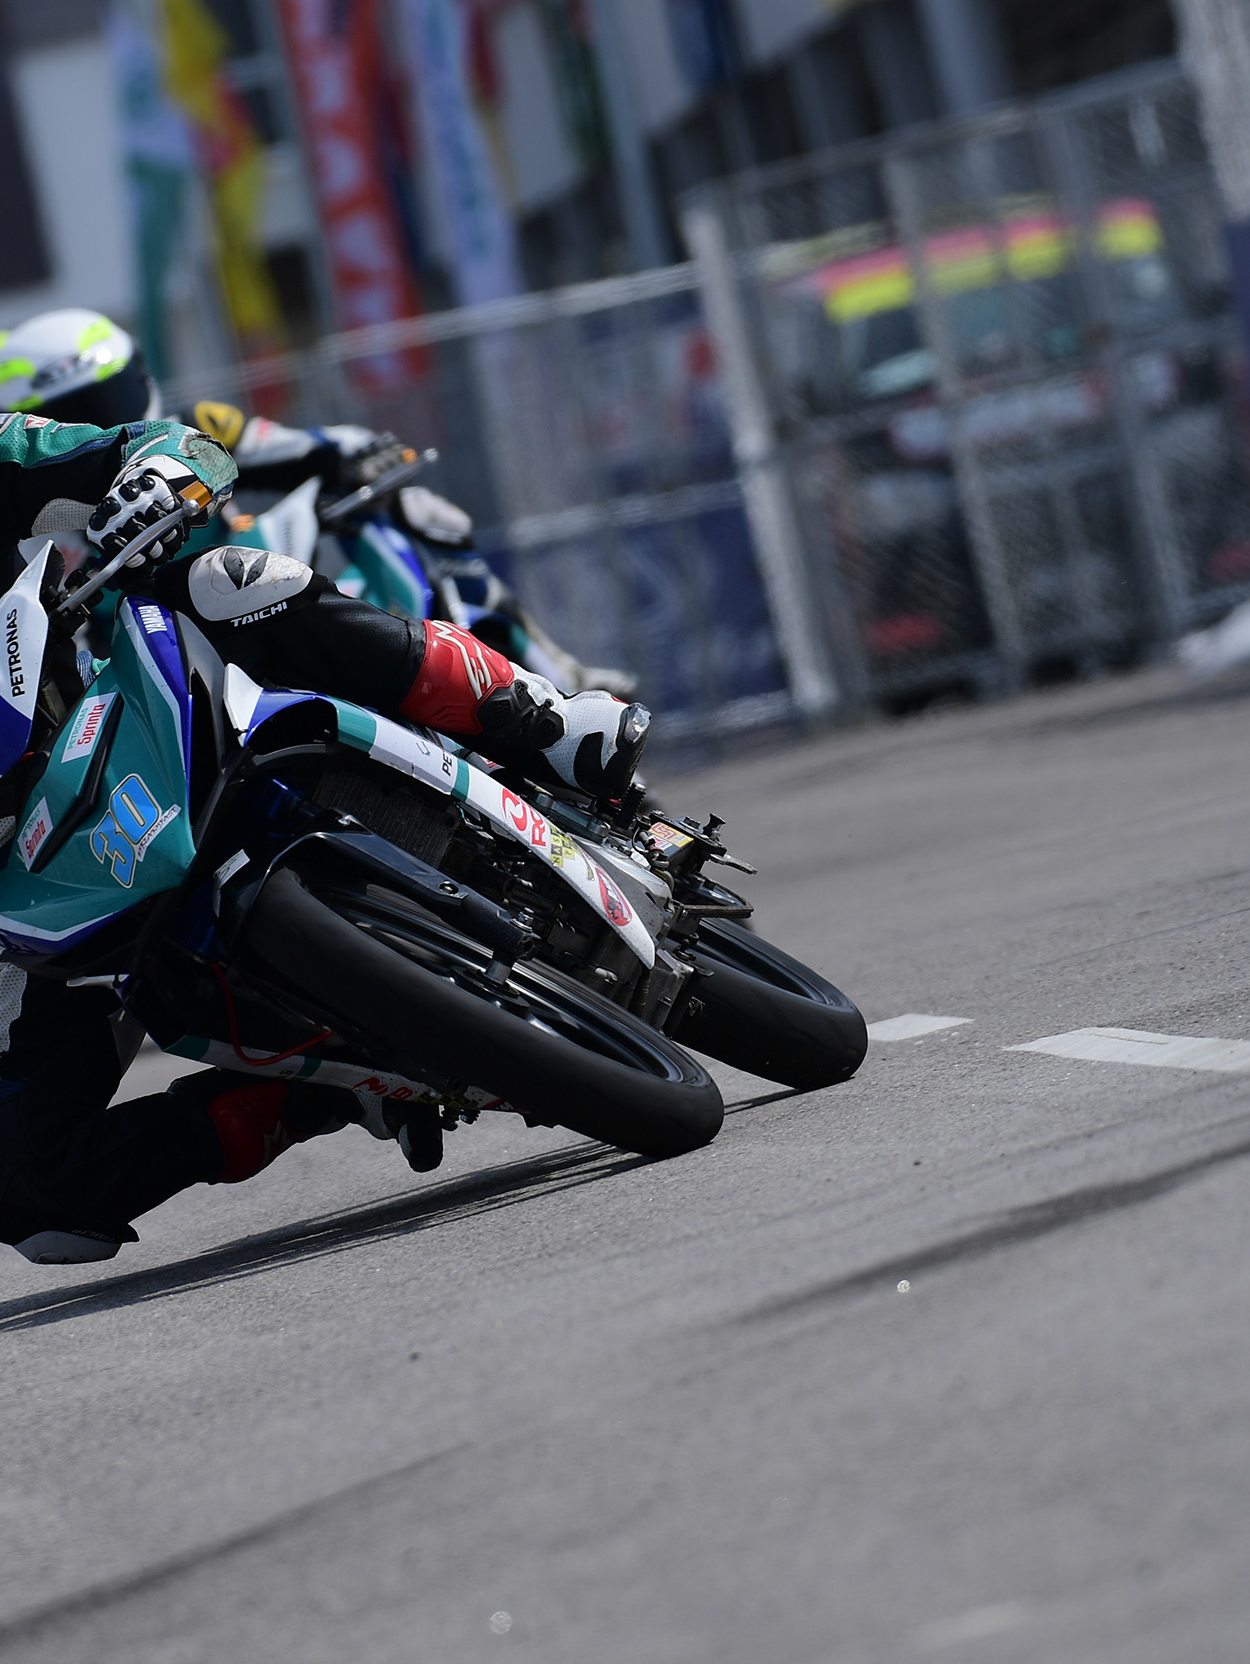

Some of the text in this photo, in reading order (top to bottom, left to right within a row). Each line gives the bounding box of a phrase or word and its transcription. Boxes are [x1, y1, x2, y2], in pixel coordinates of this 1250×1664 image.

[138, 605, 168, 634] YAMAHA
[230, 601, 288, 628] TAICHI
[6, 608, 25, 698] PETRONAS
[67, 707, 89, 750] PETRONAS
[77, 703, 107, 746] Sprinta
[90, 773, 162, 888] 30
